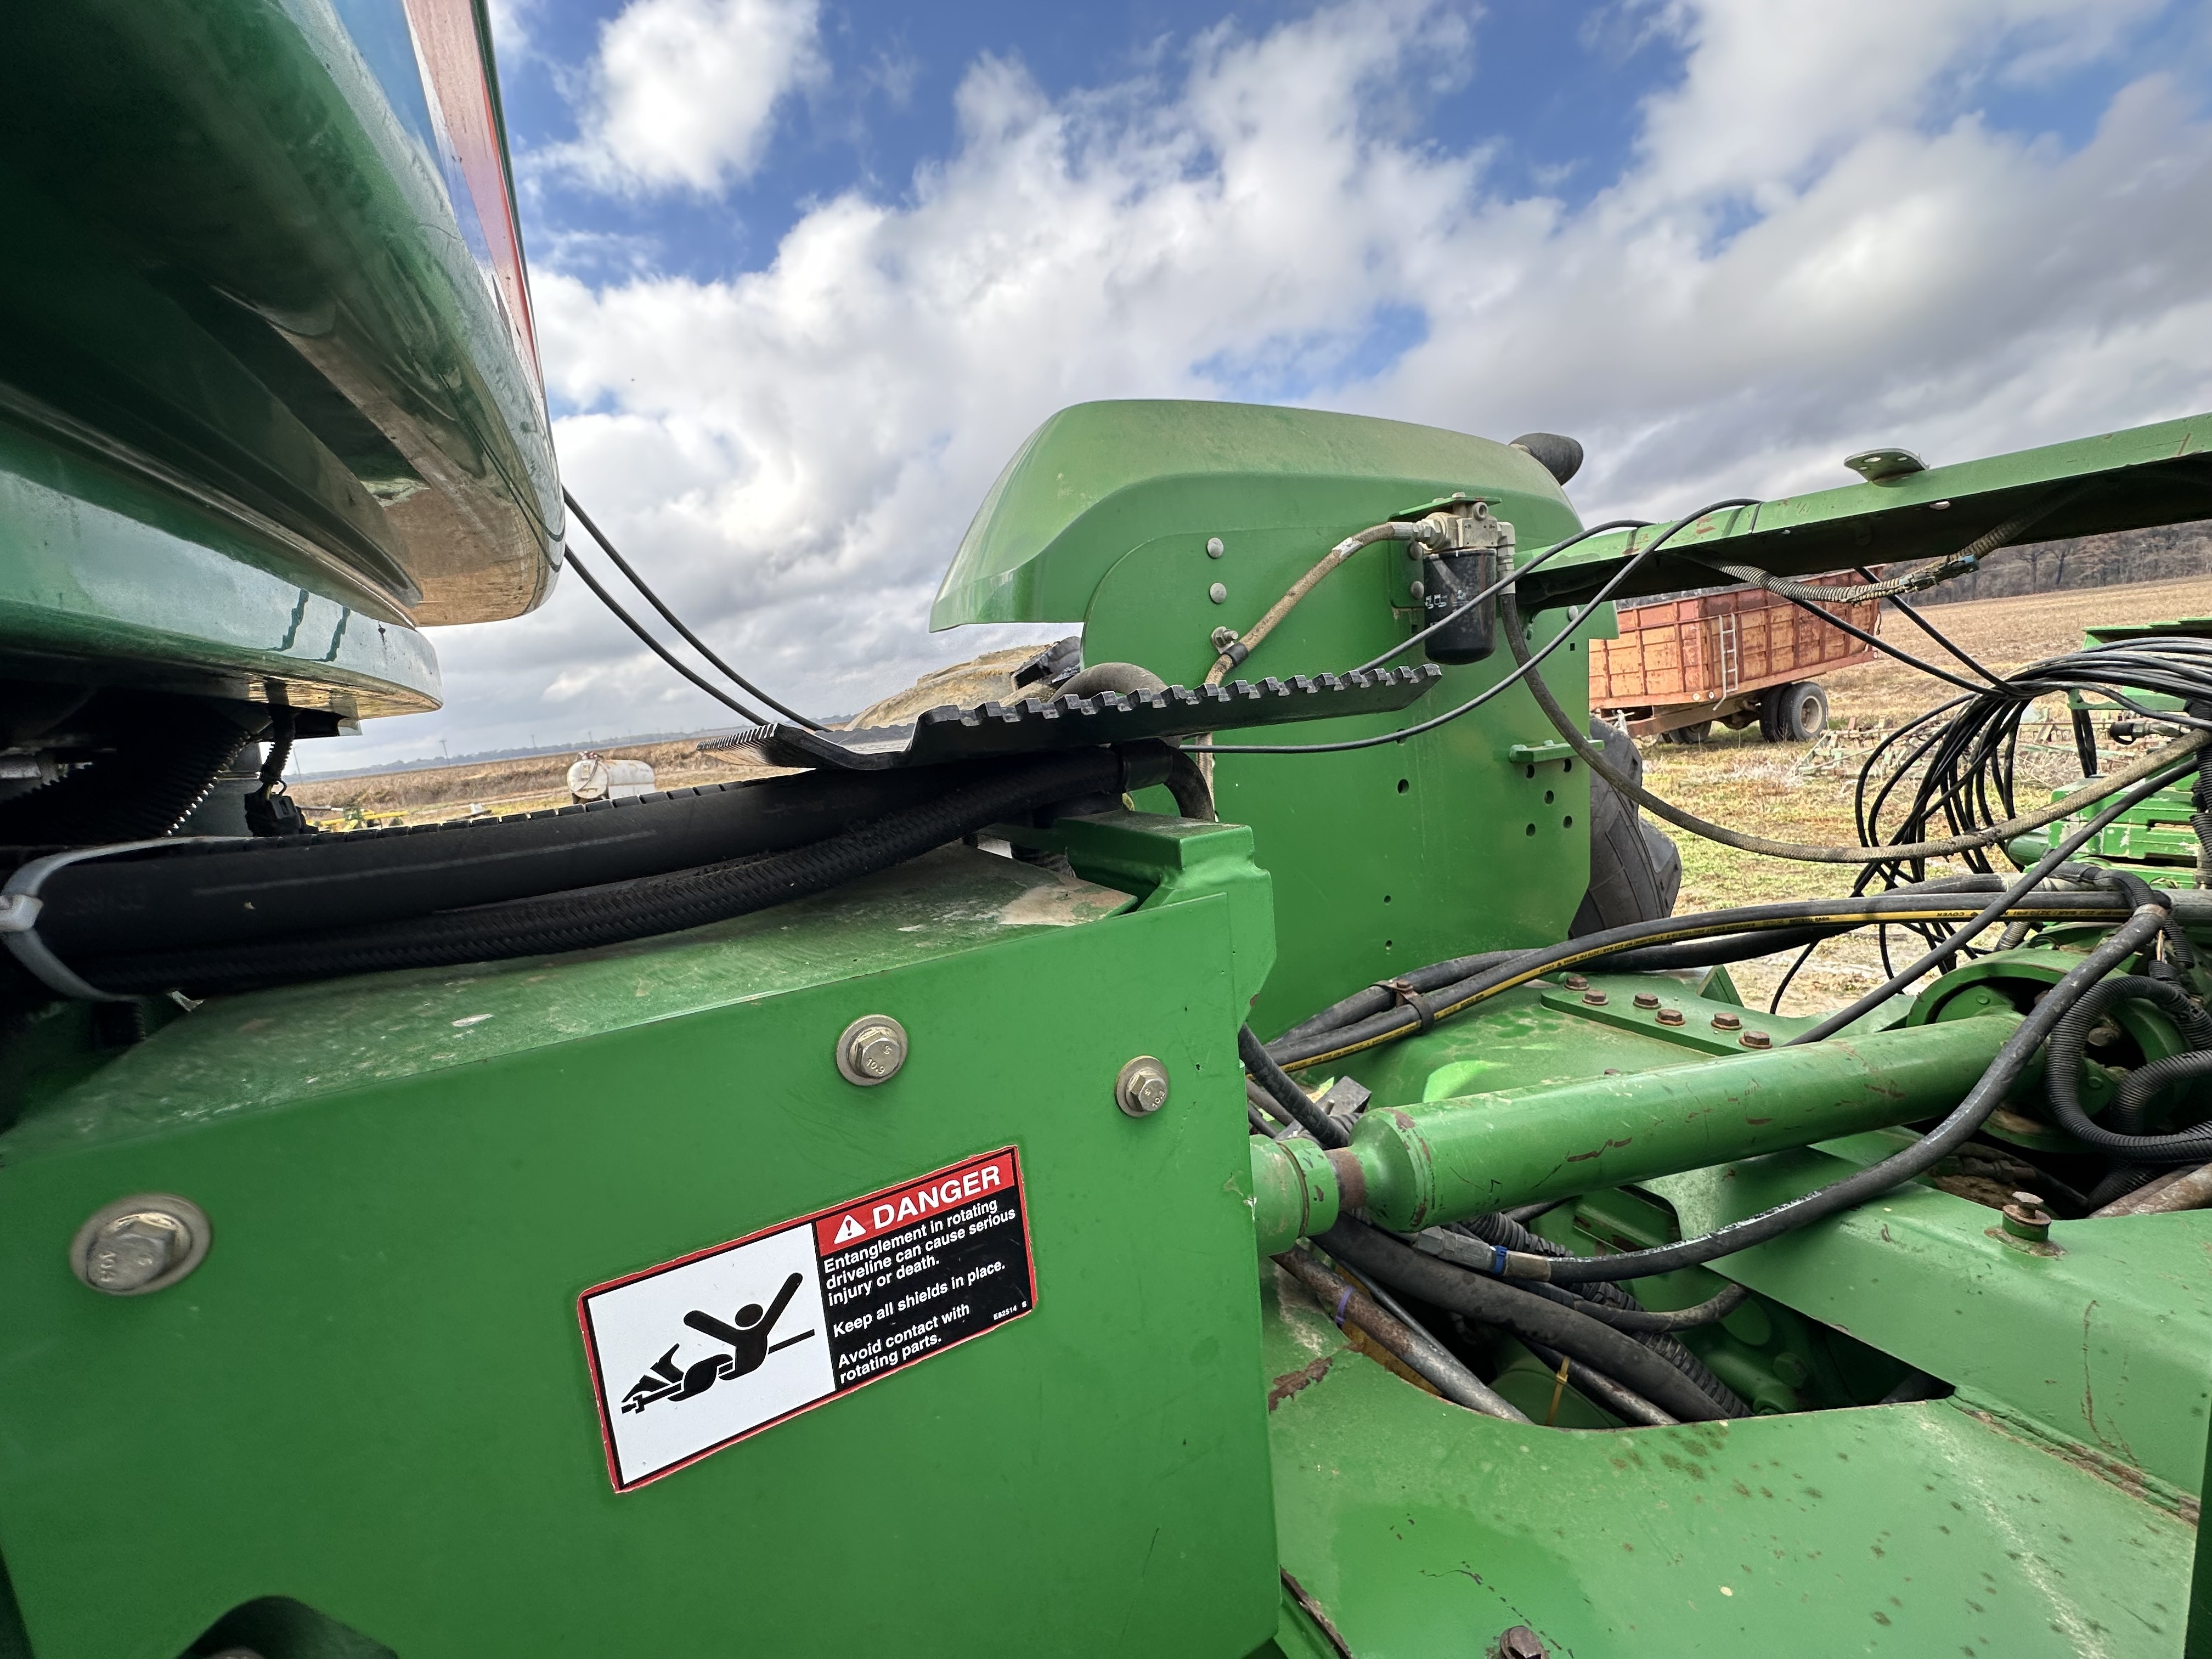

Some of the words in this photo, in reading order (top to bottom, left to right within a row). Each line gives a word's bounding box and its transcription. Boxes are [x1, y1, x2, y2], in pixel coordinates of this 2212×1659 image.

[867, 1058, 885, 1074] 10.9
[872, 1165, 1001, 1230] DANGER
[823, 1226, 928, 1273] Entanglement
[930, 1221, 943, 1234] in
[947, 1199, 997, 1229] rotating
[826, 1256, 892, 1289] driveline
[896, 1245, 922, 1262] can
[925, 1229, 966, 1251] cause
[969, 1209, 1016, 1235] serious
[828, 1279, 872, 1307] injury
[877, 1273, 893, 1287] or
[896, 1254, 939, 1279] death.
[833, 1314, 873, 1338] Keep
[877, 1301, 894, 1320] all
[898, 1282, 948, 1312] shields
[951, 1276, 964, 1289] in
[967, 1261, 1006, 1286] place.
[838, 1339, 882, 1368] Avoid
[885, 1316, 939, 1348] contact
[941, 1304, 970, 1325] with
[840, 1351, 898, 1384] rotating
[902, 1333, 943, 1360] parts.
